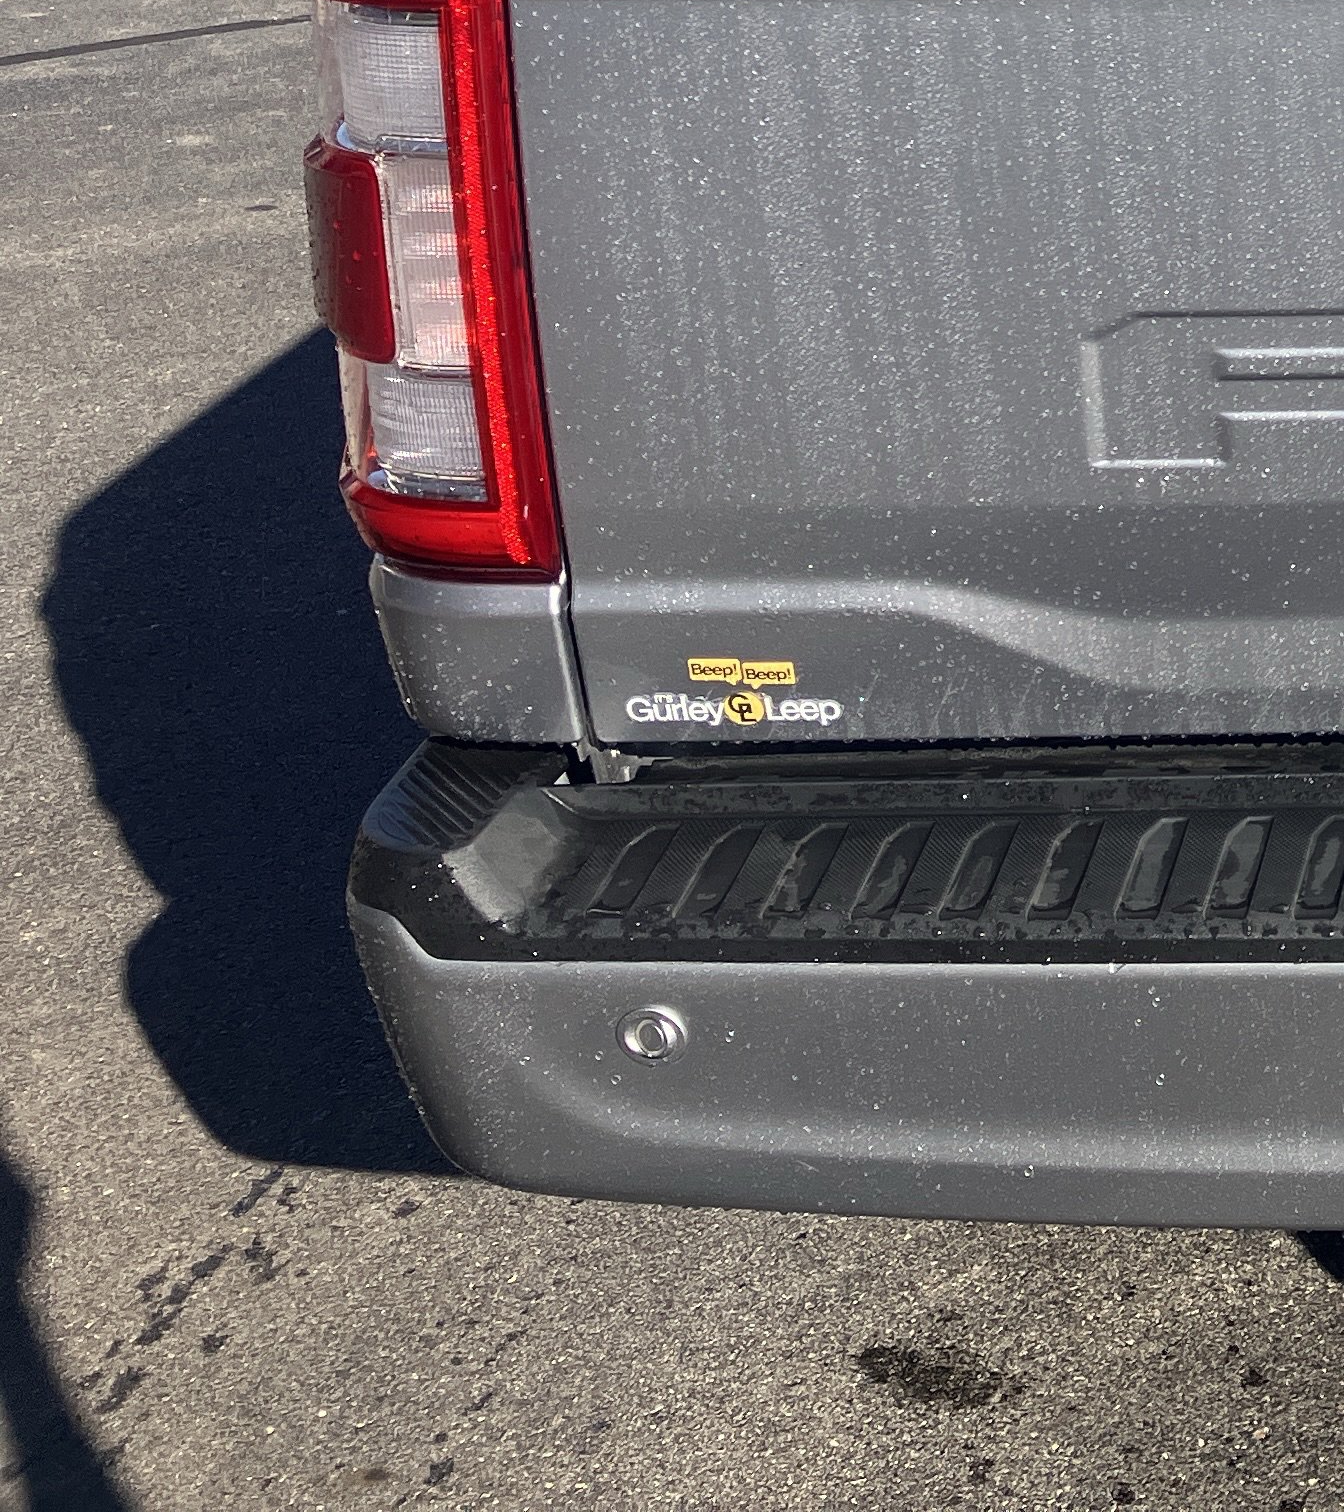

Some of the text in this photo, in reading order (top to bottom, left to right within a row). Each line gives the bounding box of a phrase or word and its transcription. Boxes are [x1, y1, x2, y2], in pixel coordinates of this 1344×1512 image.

[690, 662, 791, 682] Beep! Beep!
[625, 694, 725, 726] Gurley
[764, 696, 843, 727] Leep
